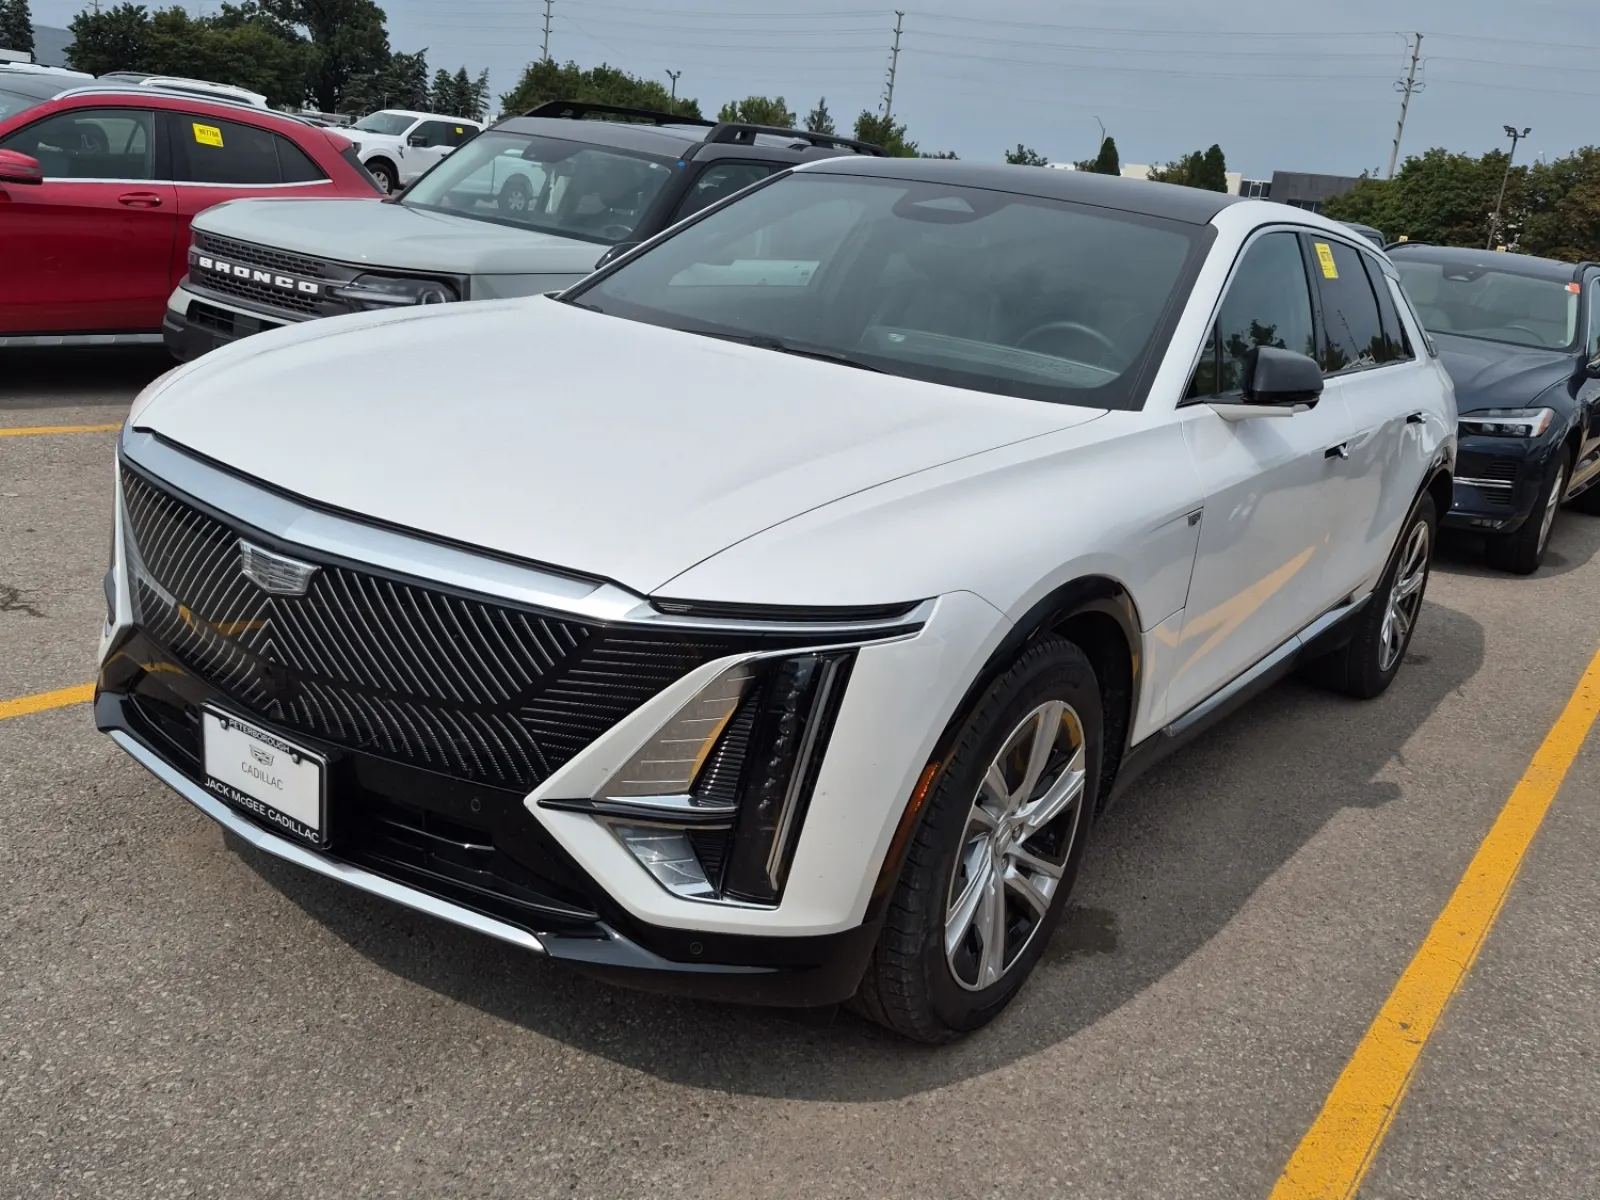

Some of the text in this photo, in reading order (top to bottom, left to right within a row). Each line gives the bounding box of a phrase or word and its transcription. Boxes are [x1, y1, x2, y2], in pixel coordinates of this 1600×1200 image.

[199, 256, 318, 294] BRONCO
[228, 719, 290, 753] PETERBOROUGH
[241, 762, 284, 790] CADILLAC
[204, 777, 319, 843] JACK McGEE CADILLAC
